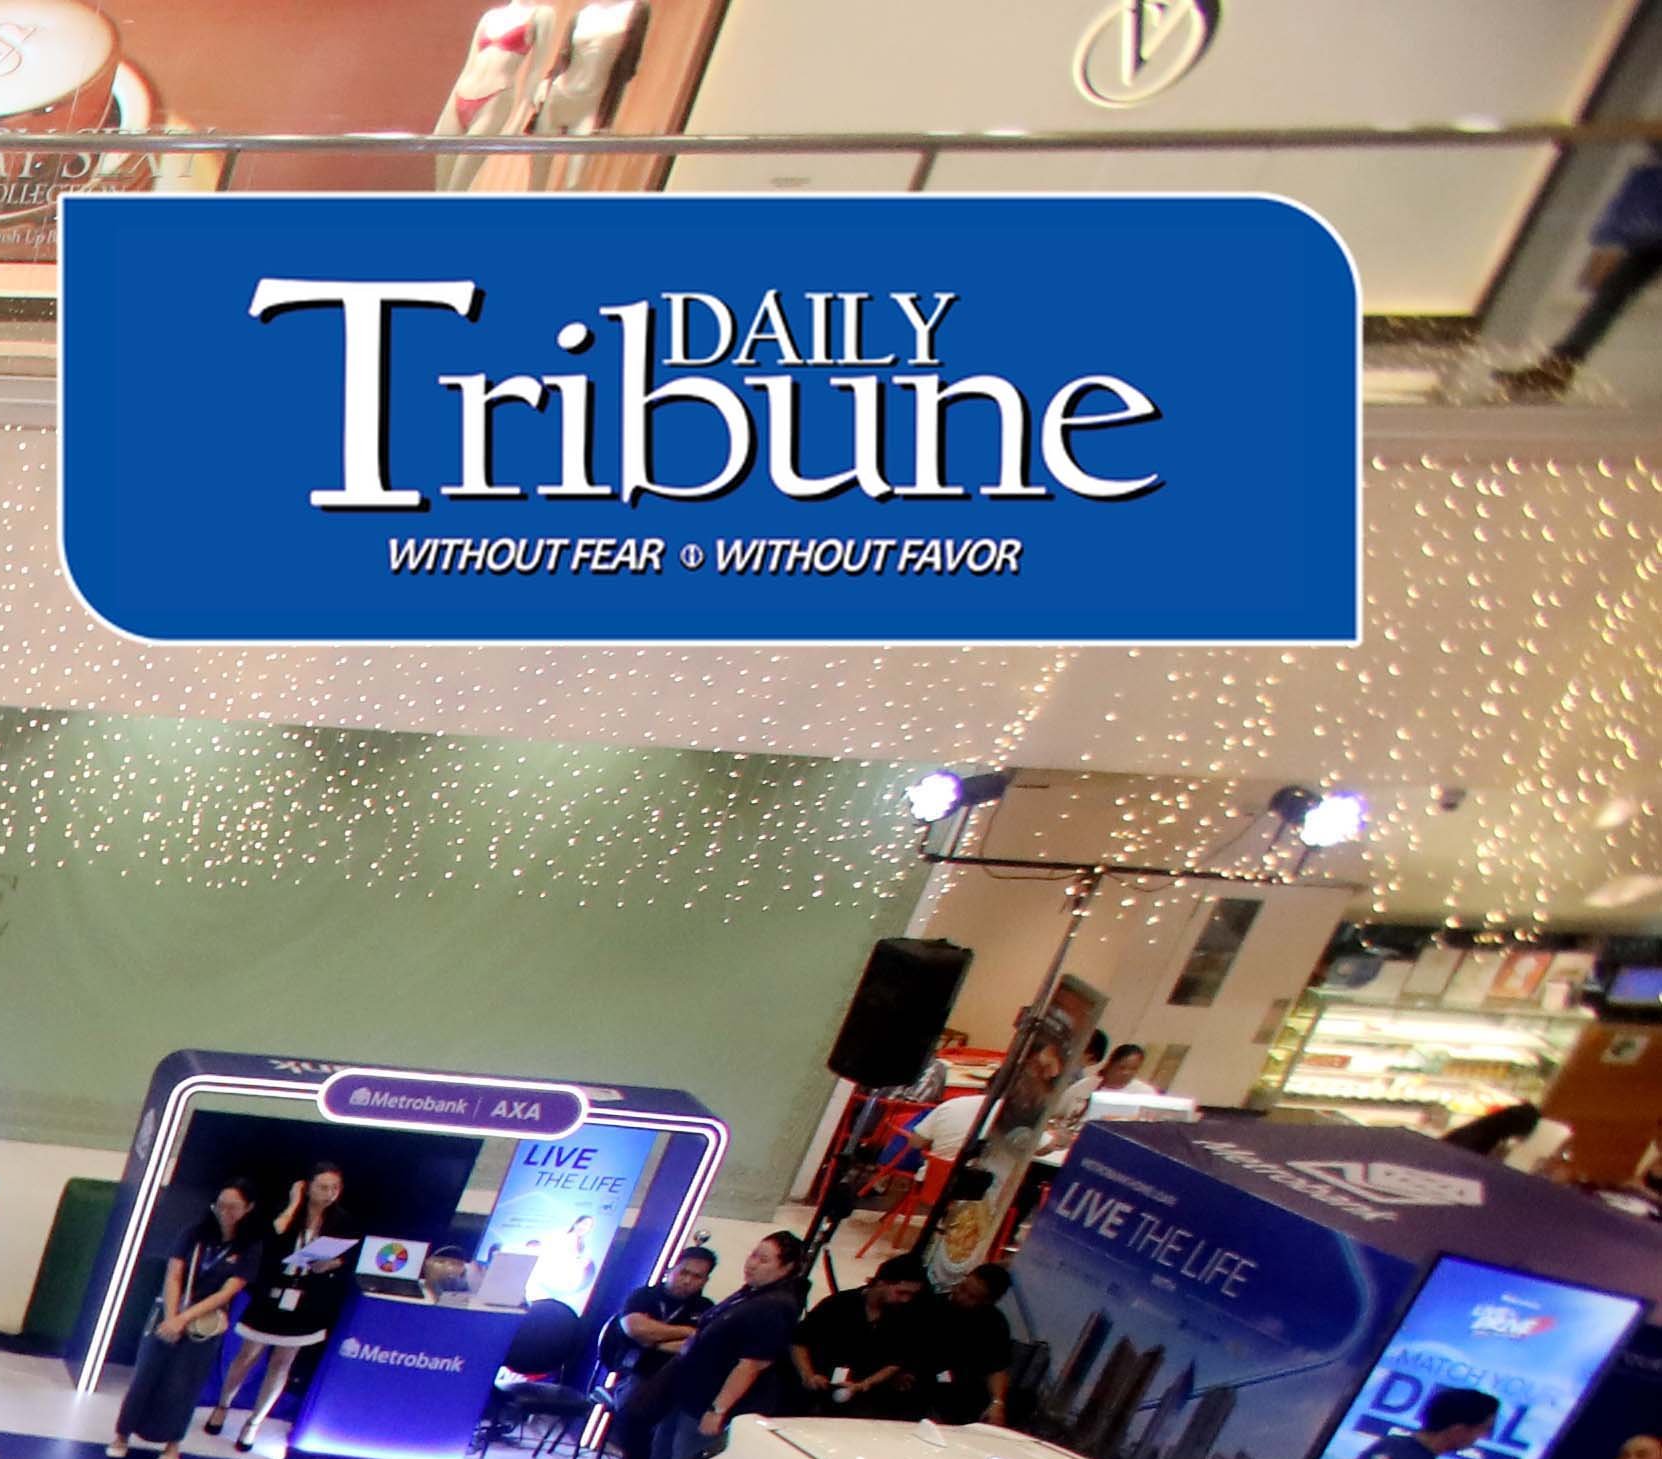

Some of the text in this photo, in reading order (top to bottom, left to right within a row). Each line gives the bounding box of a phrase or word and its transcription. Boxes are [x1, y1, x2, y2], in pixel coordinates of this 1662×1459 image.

[369, 1090, 542, 1121] Metrobank AXA
[523, 1144, 598, 1170] LIVE
[534, 1171, 627, 1194] THE LIFE
[1055, 1182, 1134, 1239] LIVE
[1124, 1199, 1191, 1268] THE
[1186, 1238, 1262, 1299] LIFE
[359, 1344, 465, 1372] Metrobank
[1394, 1348, 1486, 1383] MATCH
[1371, 1367, 1530, 1452] DL
